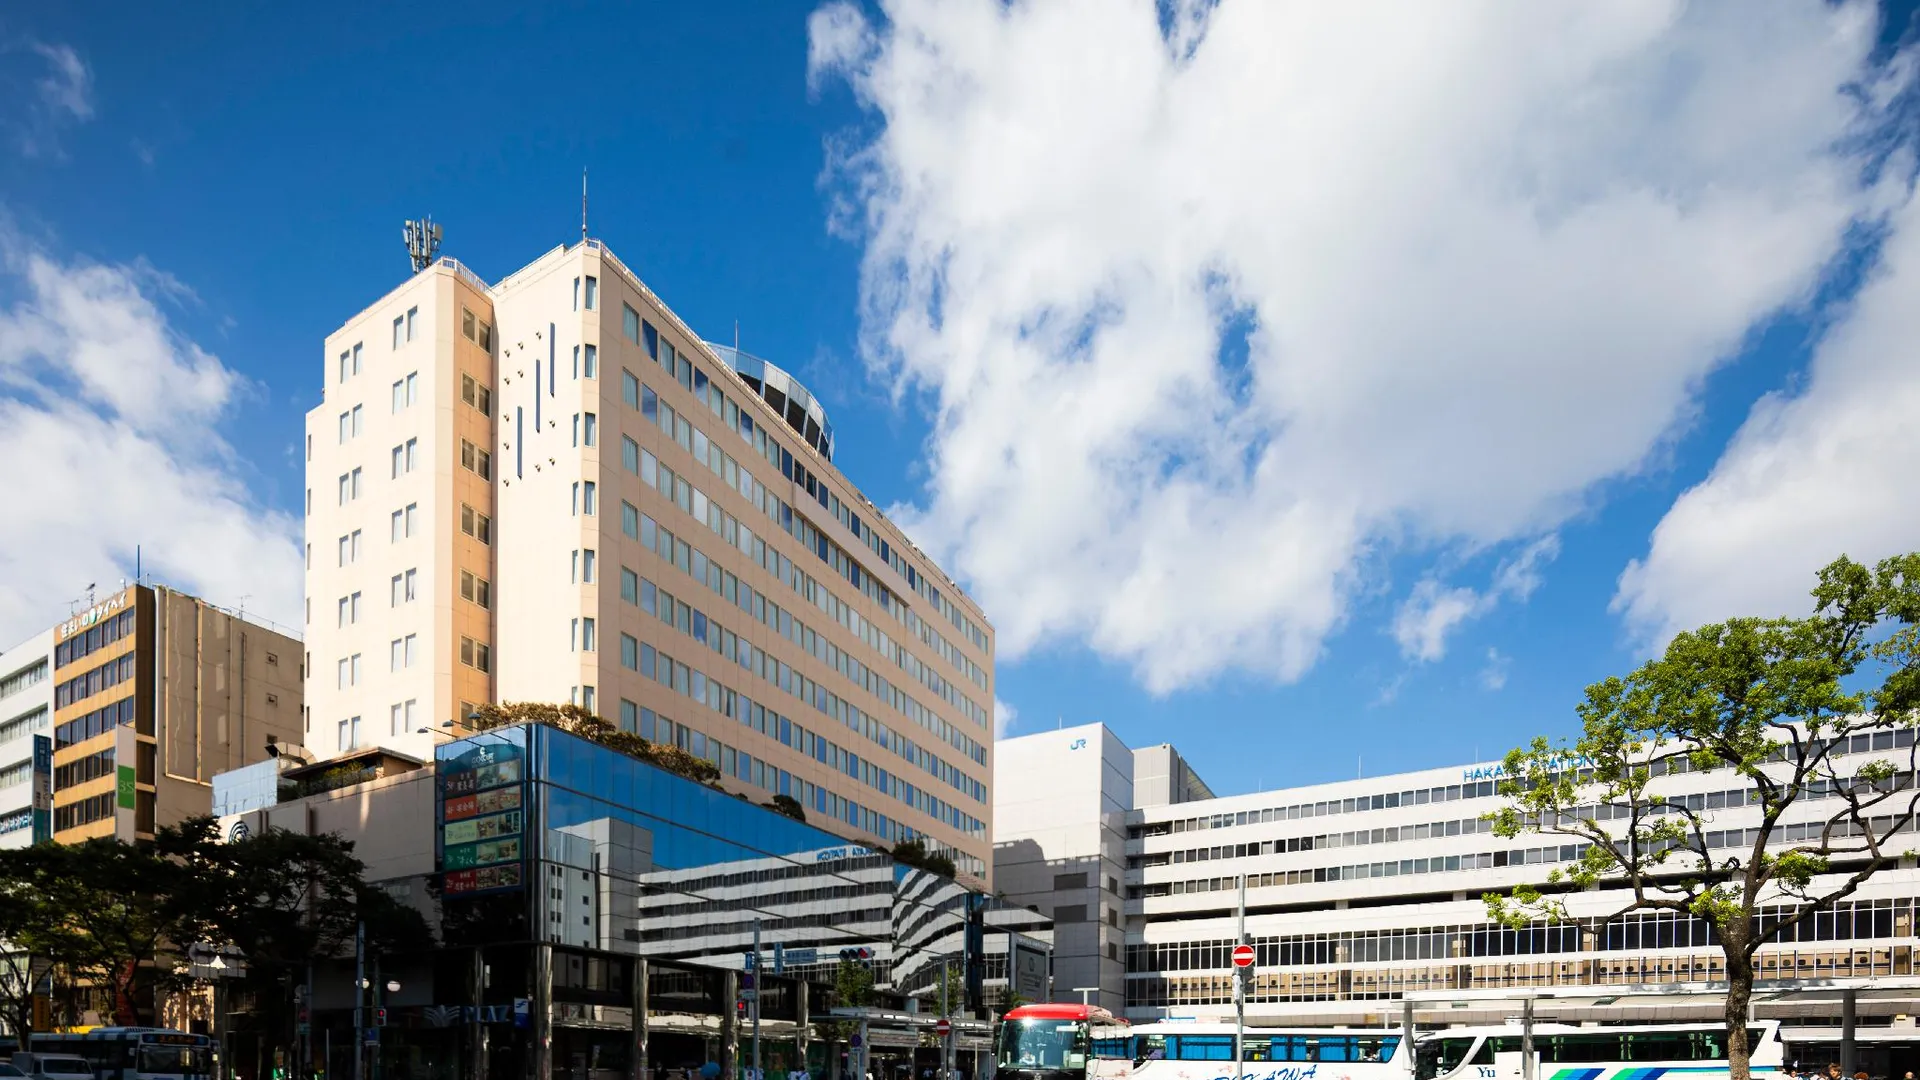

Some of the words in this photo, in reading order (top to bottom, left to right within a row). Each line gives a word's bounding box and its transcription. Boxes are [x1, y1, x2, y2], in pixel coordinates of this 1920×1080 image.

[1070, 738, 1086, 750] JR
[1463, 764, 1510, 782] HAKA
[1477, 1067, 1496, 1078] Yu
